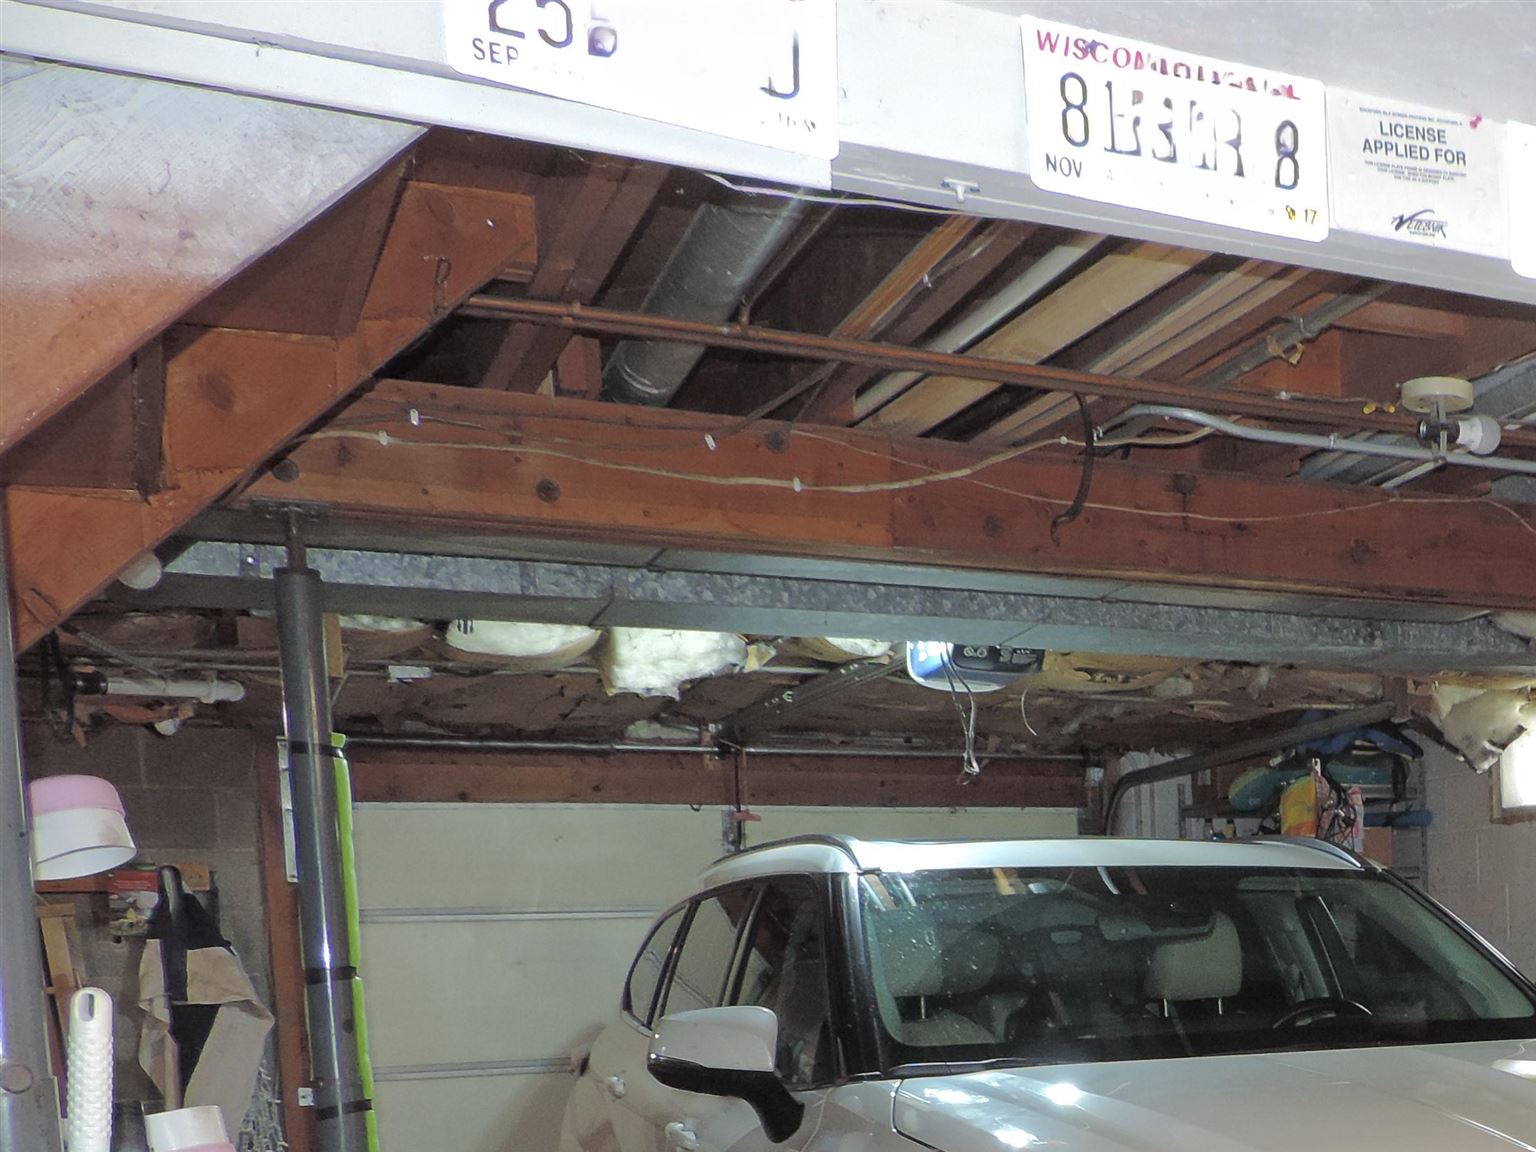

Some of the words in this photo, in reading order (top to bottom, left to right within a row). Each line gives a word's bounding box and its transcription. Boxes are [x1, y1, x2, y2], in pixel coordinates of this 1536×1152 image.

[472, 37, 520, 65] SEP
[1379, 121, 1447, 144] LICENSE
[1045, 152, 1083, 178] NOV
[1362, 138, 1430, 160] APPLIED
[1434, 148, 1467, 166] FOR
